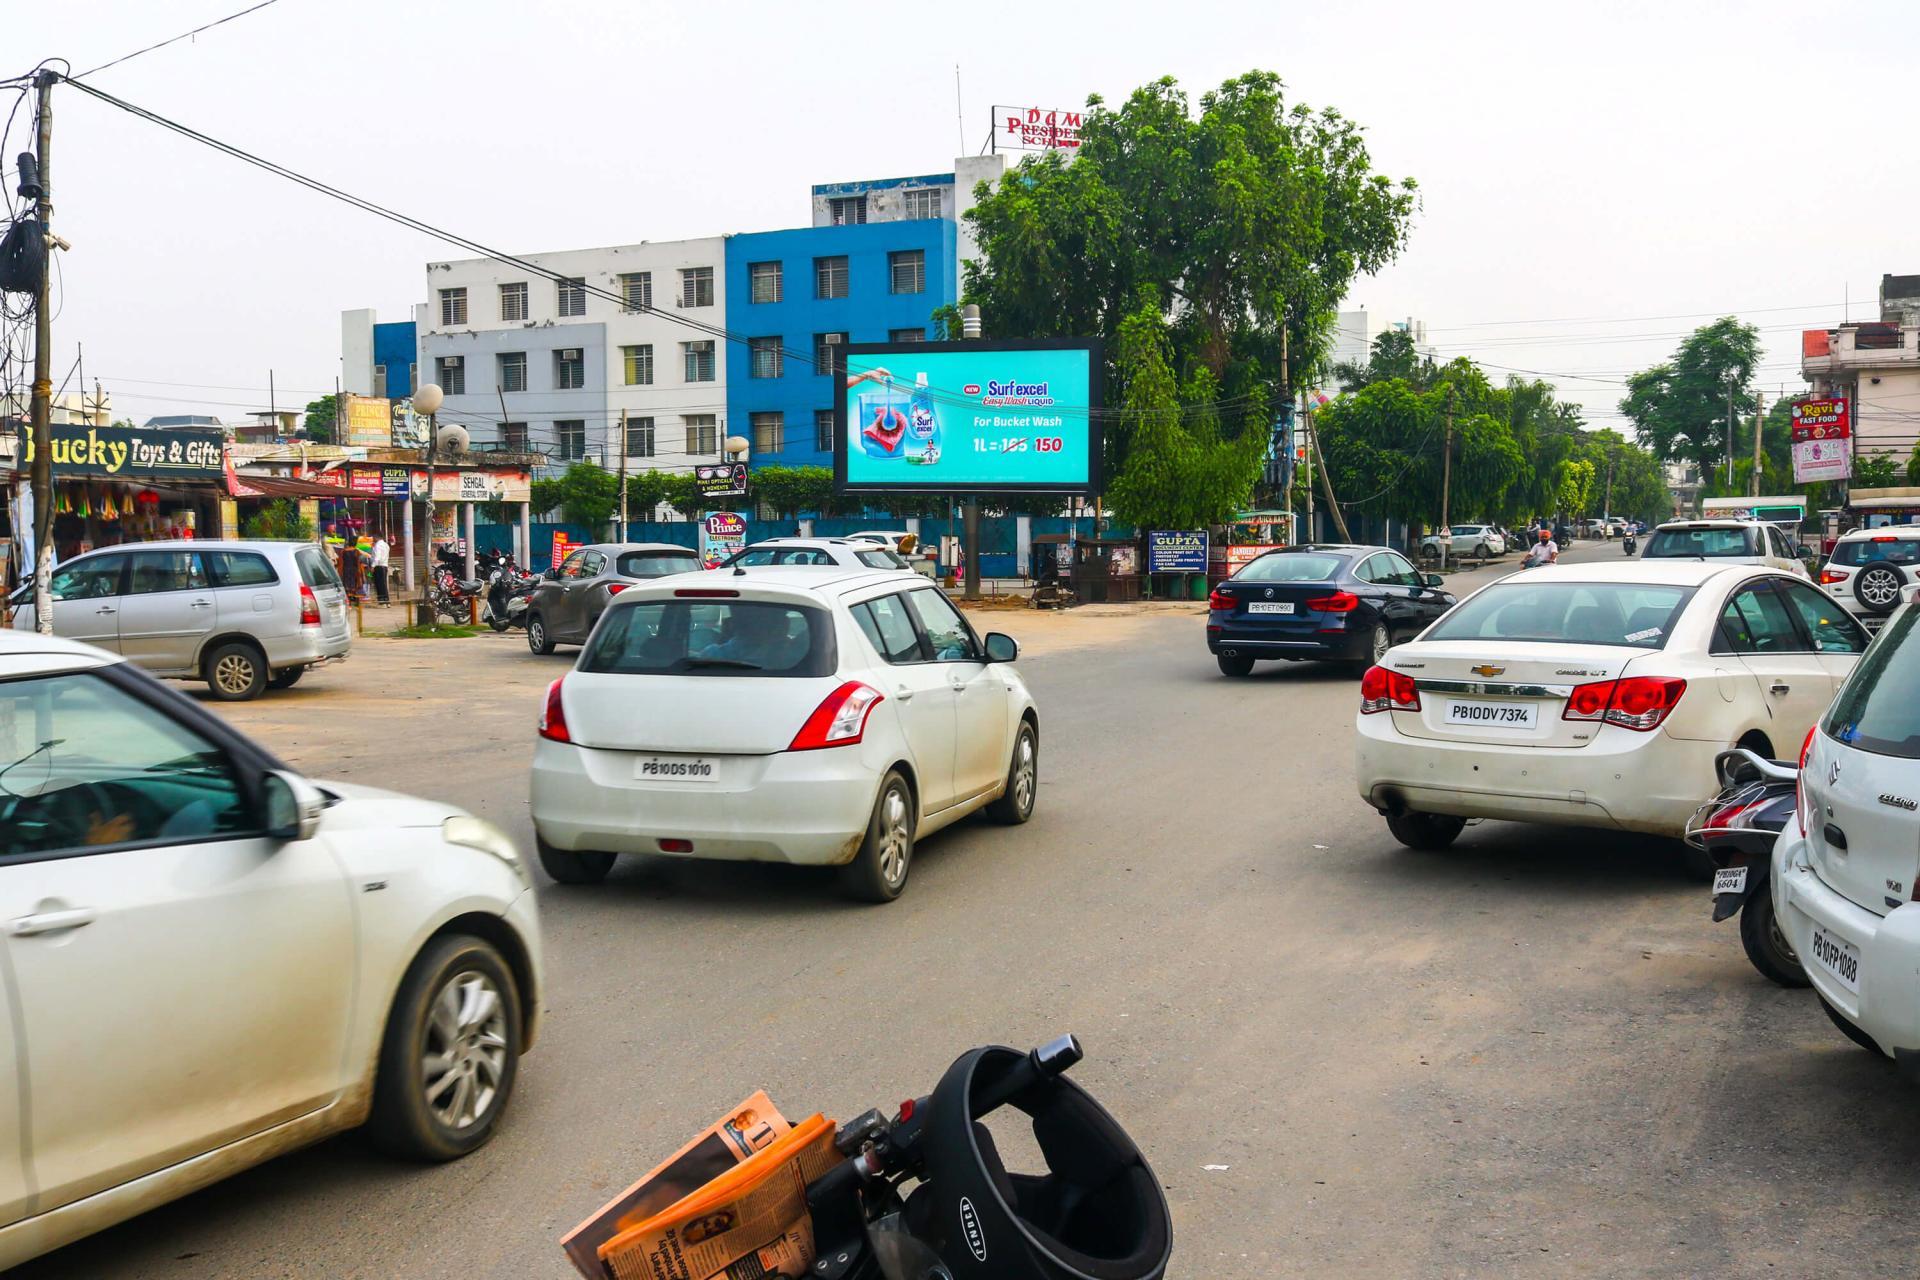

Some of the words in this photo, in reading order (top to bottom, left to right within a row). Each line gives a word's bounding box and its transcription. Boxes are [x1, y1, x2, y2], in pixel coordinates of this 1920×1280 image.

[988, 380, 1015, 396] Surf
[1015, 382, 1048, 396] excel
[983, 396, 1003, 407] Easy
[1027, 398, 1054, 406] LIQUID
[1802, 402, 1834, 417] Ravi
[917, 415, 933, 426] Surf
[974, 416, 992, 427] For
[993, 416, 1030, 427] Bucket
[1032, 416, 1063, 427] Wash
[1800, 416, 1816, 425] FAST
[1818, 415, 1838, 423] FOOD
[1034, 438, 1063, 451] 150
[131, 438, 166, 468] Toys
[168, 441, 183, 463] &
[186, 441, 222, 469] Gifts
[384, 469, 407, 477] GUPTA
[463, 476, 486, 489] SEHGAL
[709, 517, 743, 534] Prince
[1156, 537, 1201, 545] GUPTA
[1717, 879, 1738, 889] 6604
[1813, 931, 1858, 984] PB10FP1088
